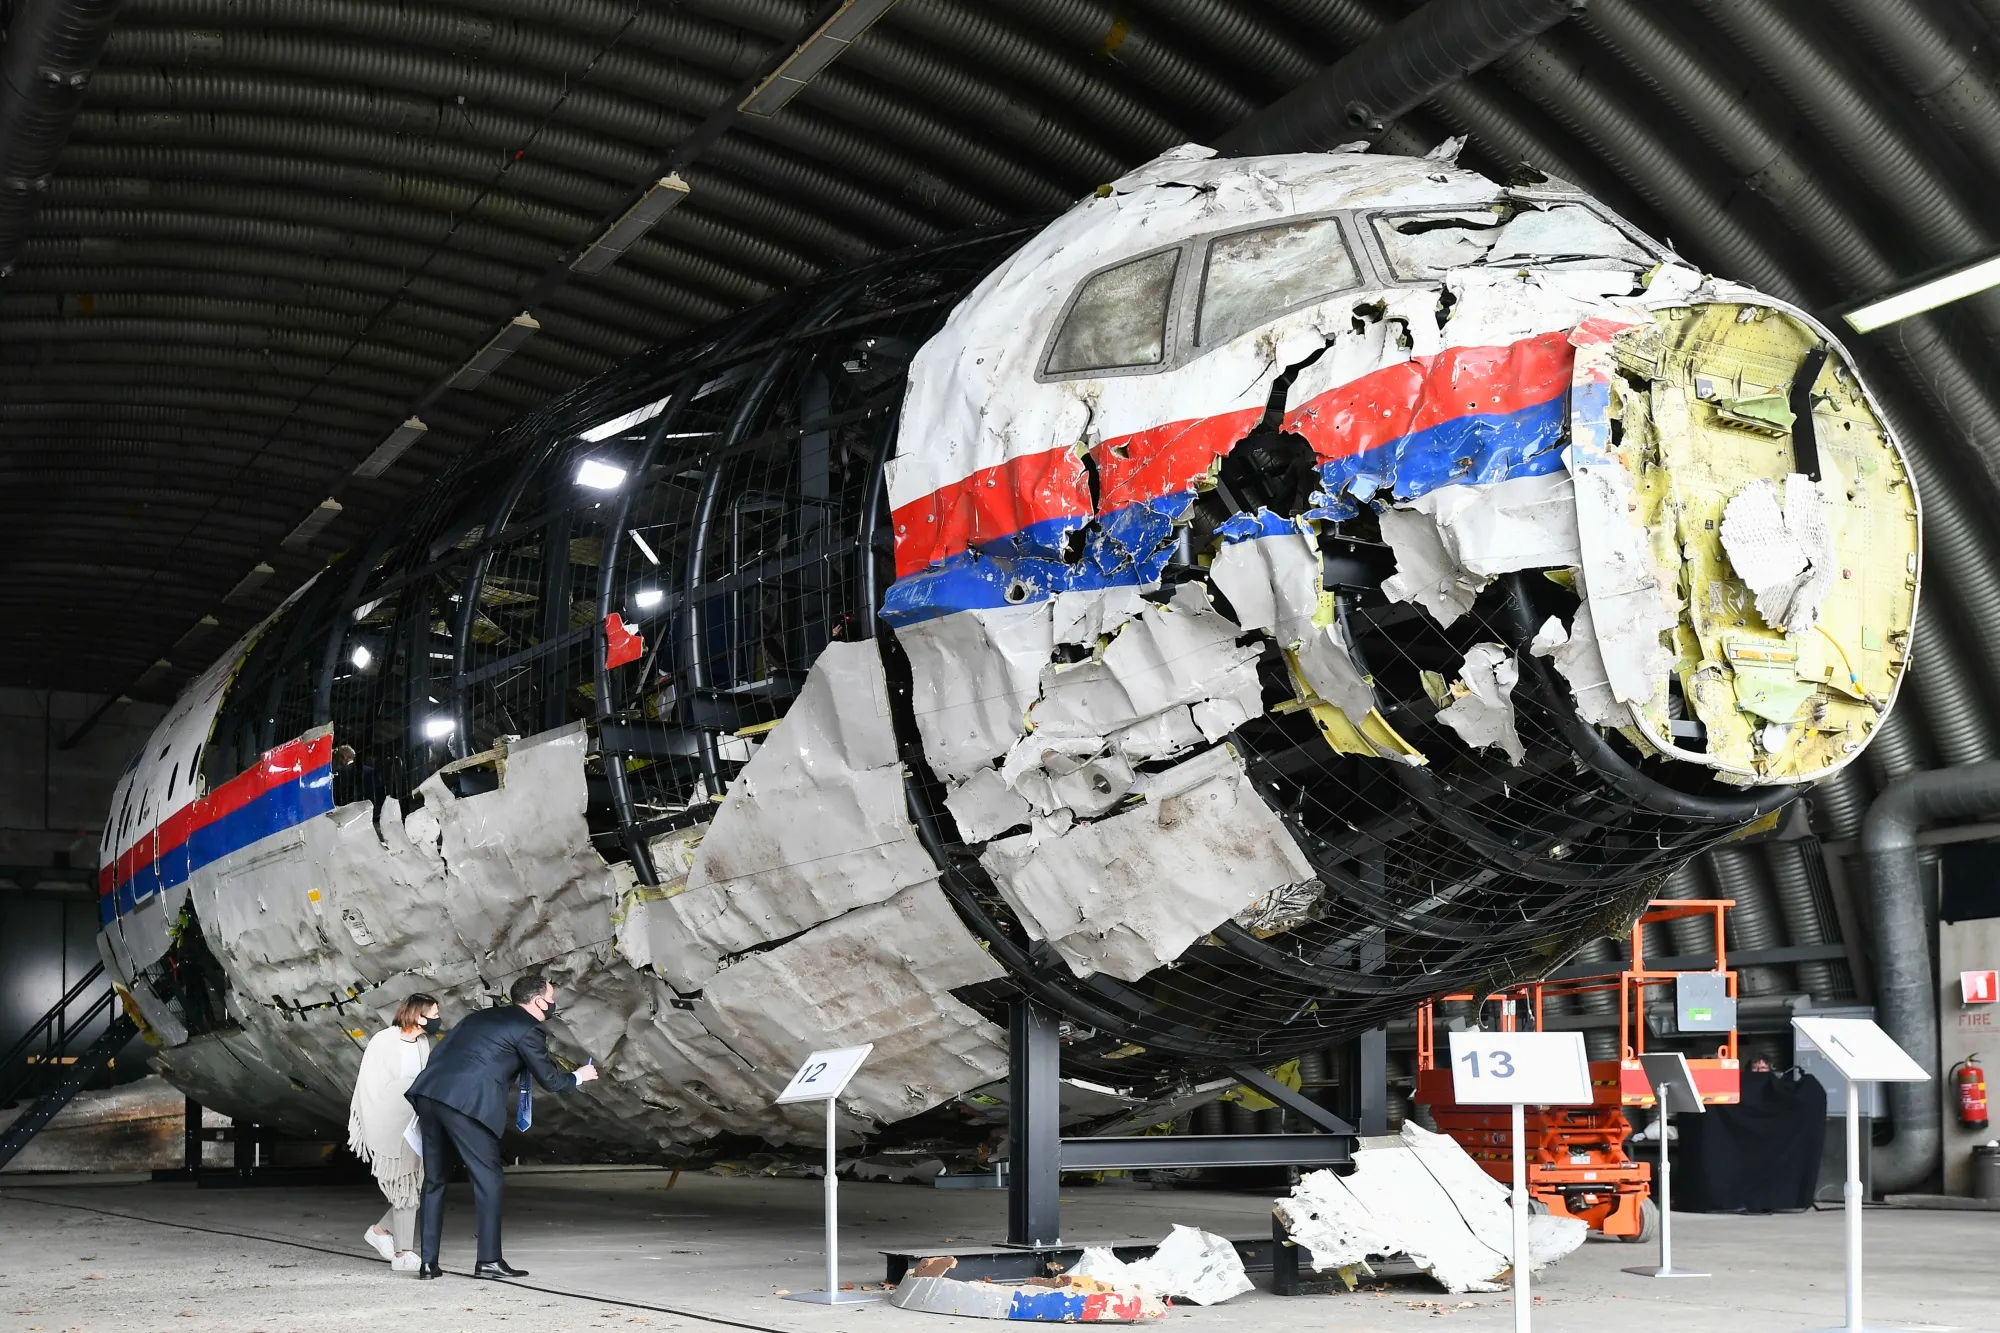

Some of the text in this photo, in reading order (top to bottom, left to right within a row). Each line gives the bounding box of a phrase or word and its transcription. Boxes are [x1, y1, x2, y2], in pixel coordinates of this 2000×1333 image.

[1959, 1013, 1991, 1026] FIRE
[1830, 1035, 1855, 1057] 1
[798, 1062, 827, 1083] 12
[1461, 1051, 1515, 1078] 13
